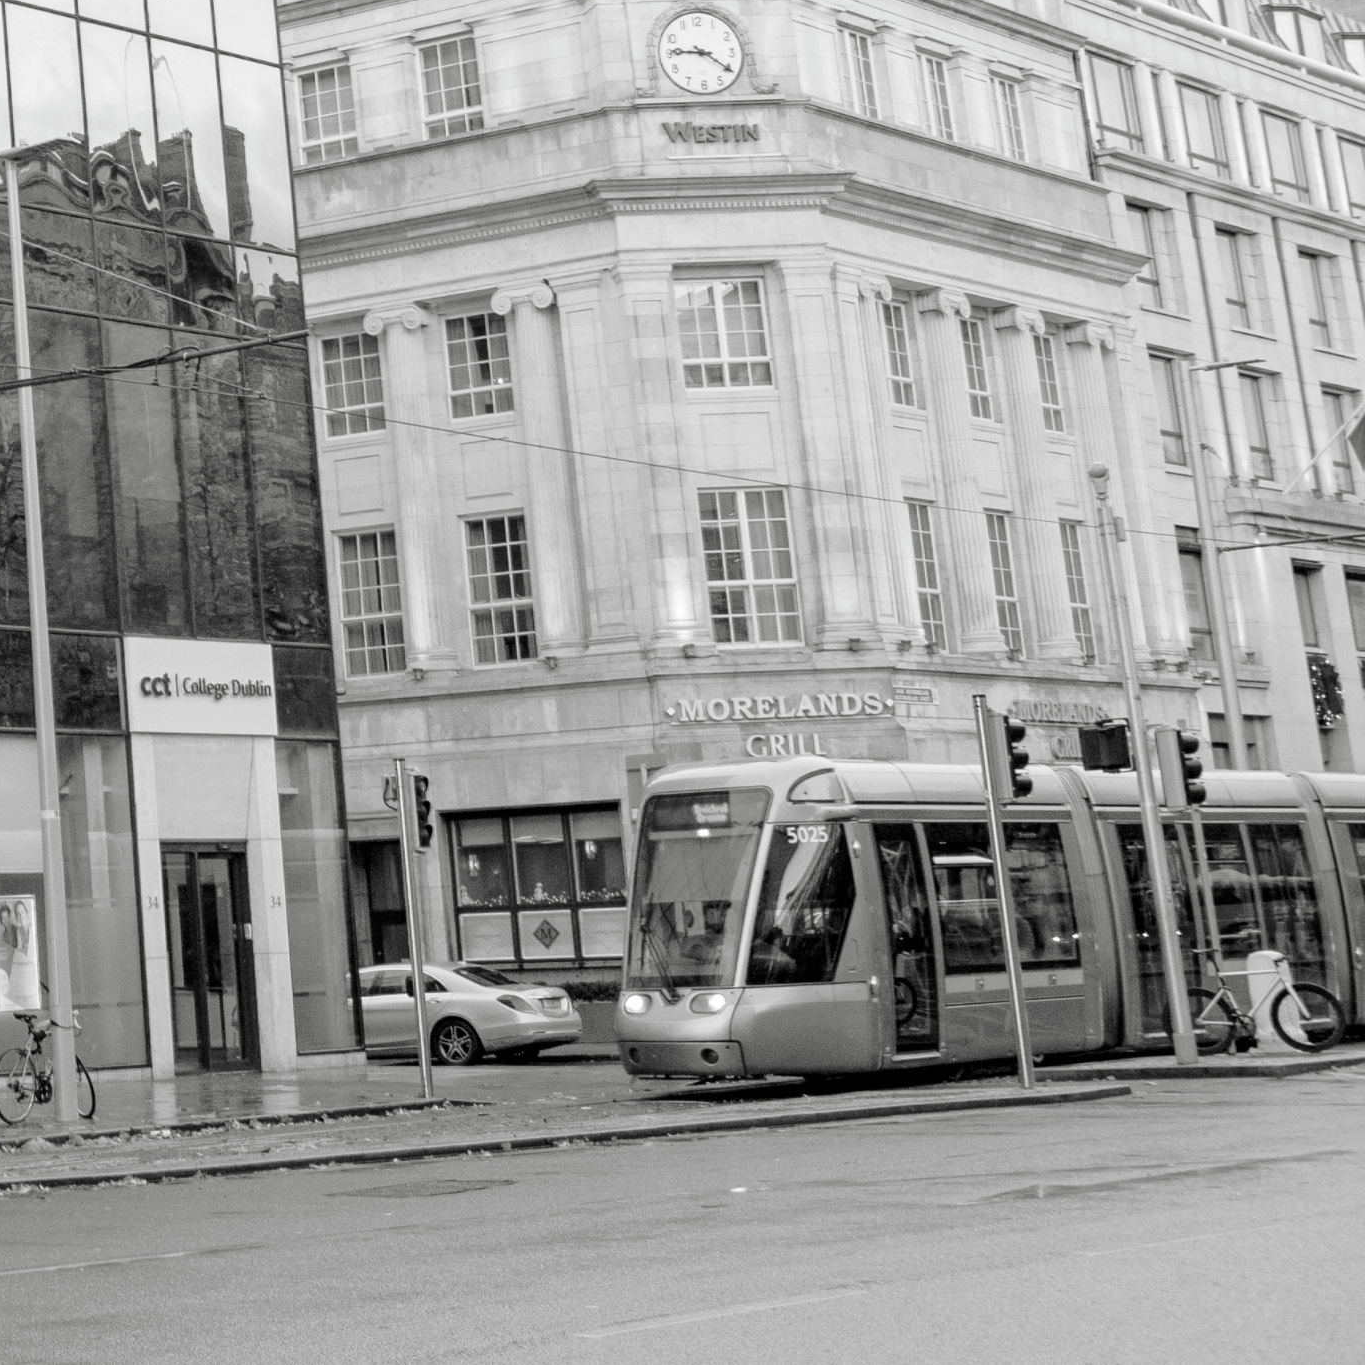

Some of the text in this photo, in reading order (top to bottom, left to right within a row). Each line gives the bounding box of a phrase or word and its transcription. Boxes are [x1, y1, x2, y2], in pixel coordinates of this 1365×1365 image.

[679, 20, 687, 30] 11
[691, 16, 702, 27] 12
[711, 19, 715, 30] 1
[667, 33, 676, 44] 10
[723, 31, 731, 42] 2
[728, 47, 736, 58] 3
[671, 63, 679, 74] 8
[684, 76, 692, 87] 7
[700, 79, 708, 91] 6
[716, 75, 724, 86] 5
[661, 121, 760, 144] WESTIN
[140, 672, 272, 701] cct College Dublin
[677, 692, 884, 722] MORELANDS
[1015, 700, 1103, 724] MORELANDS
[745, 733, 828, 758] GRILL
[785, 825, 829, 844] 5025
